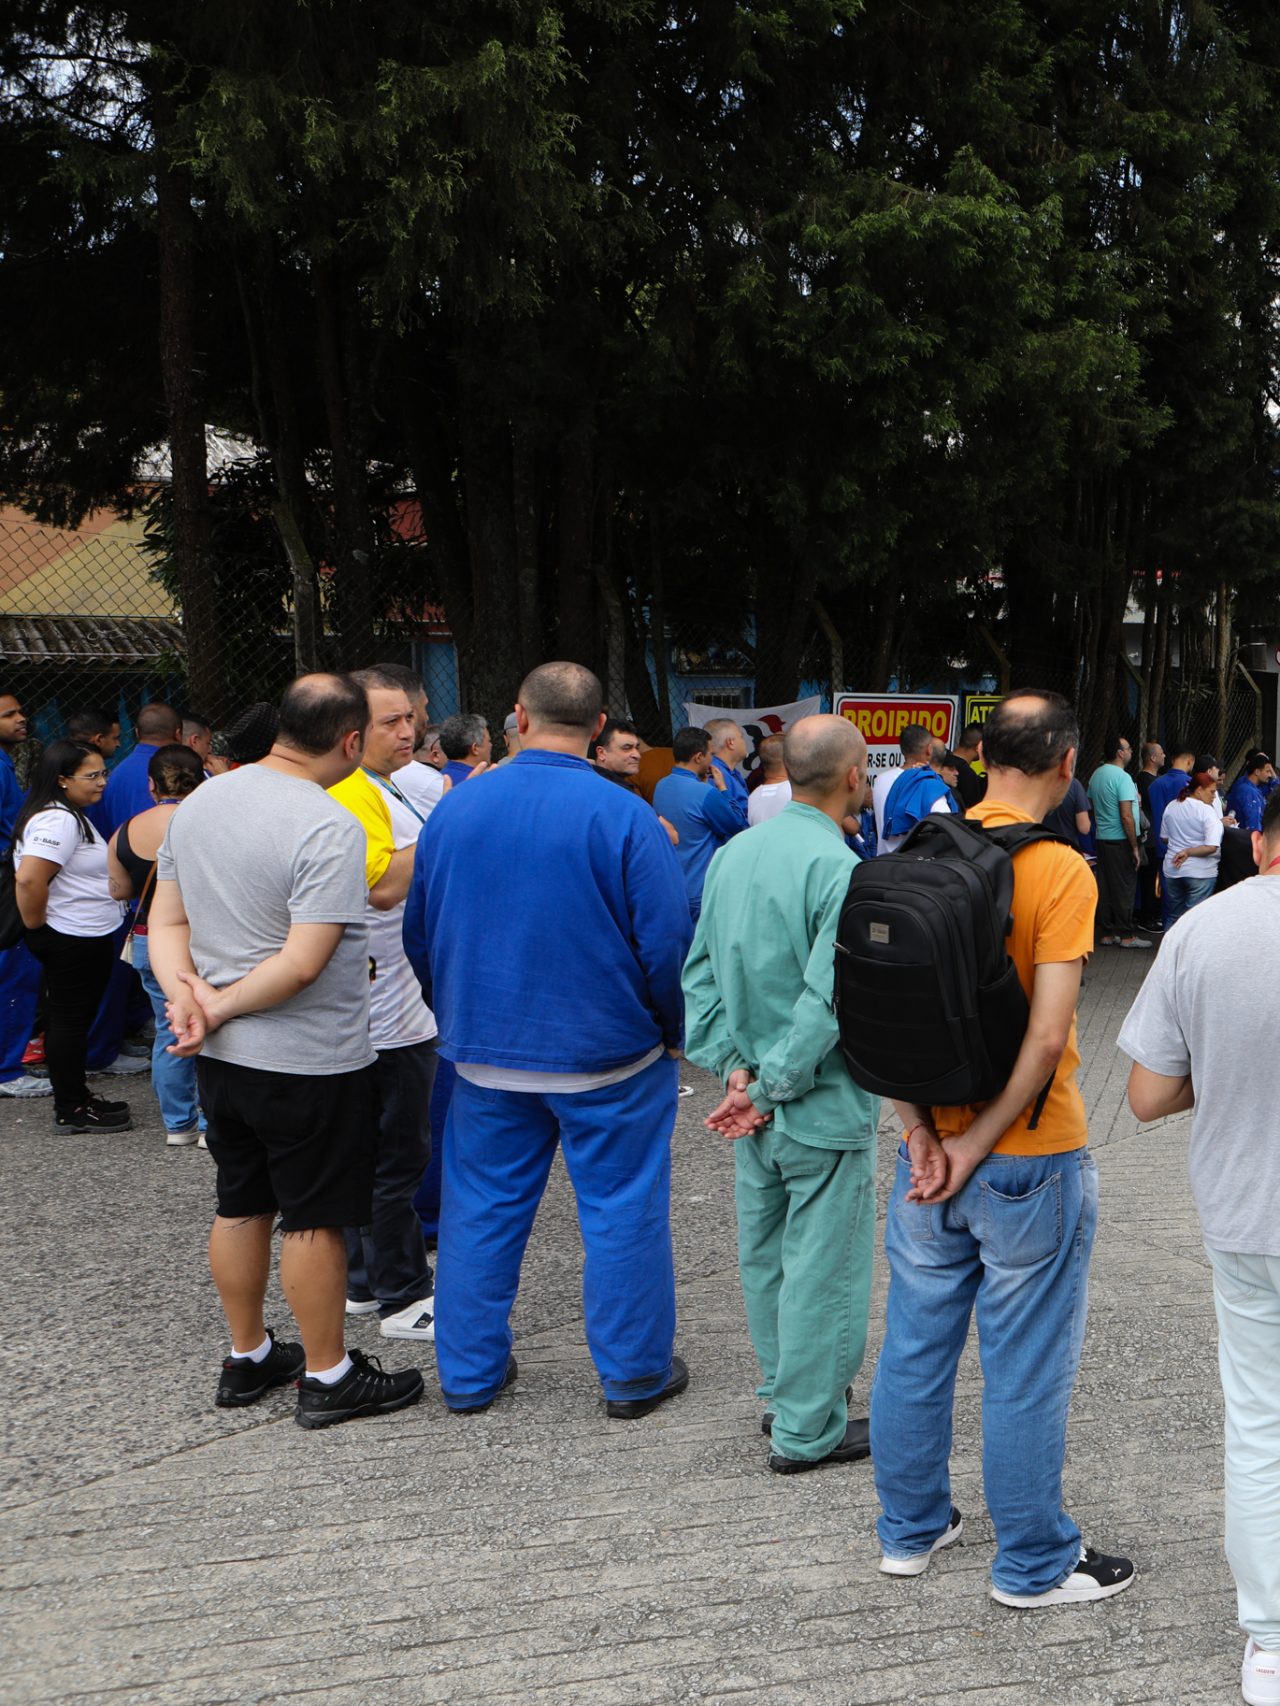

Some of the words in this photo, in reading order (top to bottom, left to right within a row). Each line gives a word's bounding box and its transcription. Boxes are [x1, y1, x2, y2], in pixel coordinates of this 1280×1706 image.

[843, 710, 947, 737] PROIBIDO
[867, 753, 887, 768] R-SE
[889, 753, 901, 767] OU
